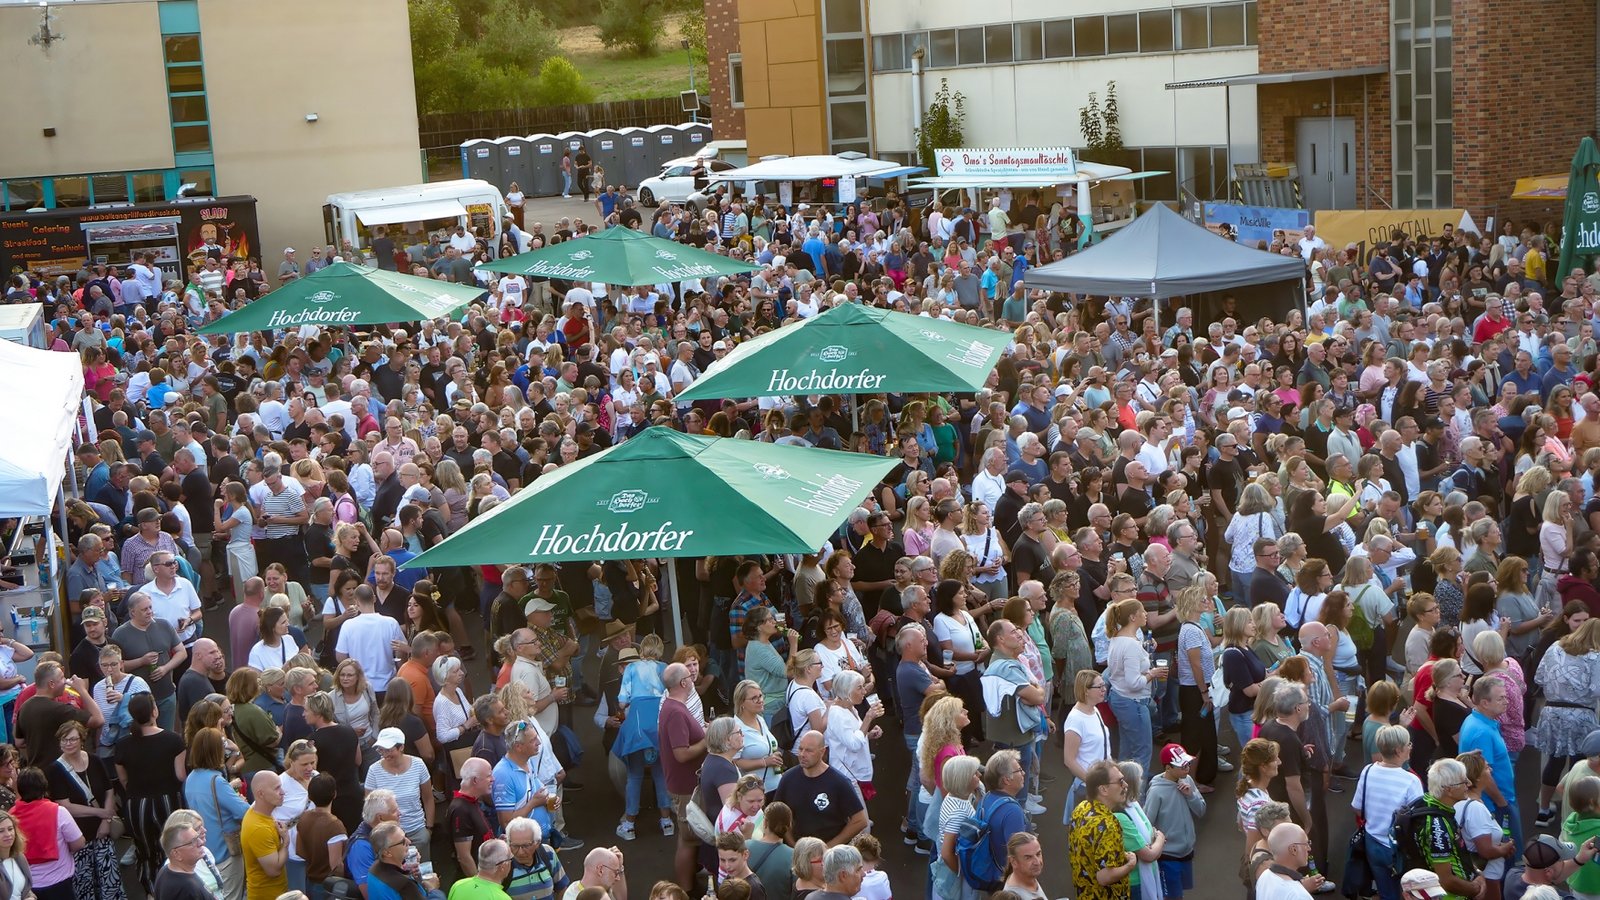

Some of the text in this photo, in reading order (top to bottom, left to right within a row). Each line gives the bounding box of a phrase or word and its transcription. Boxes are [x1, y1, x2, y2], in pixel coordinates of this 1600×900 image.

[963, 152, 1068, 168] Oma's Sonntagsmaultäschle
[32, 224, 71, 234] Catering
[524, 259, 597, 279] Hochdorfer
[267, 306, 361, 327] Hochdorfer
[766, 368, 886, 392] Hochdorfer
[529, 520, 695, 556] Hochdorfer
